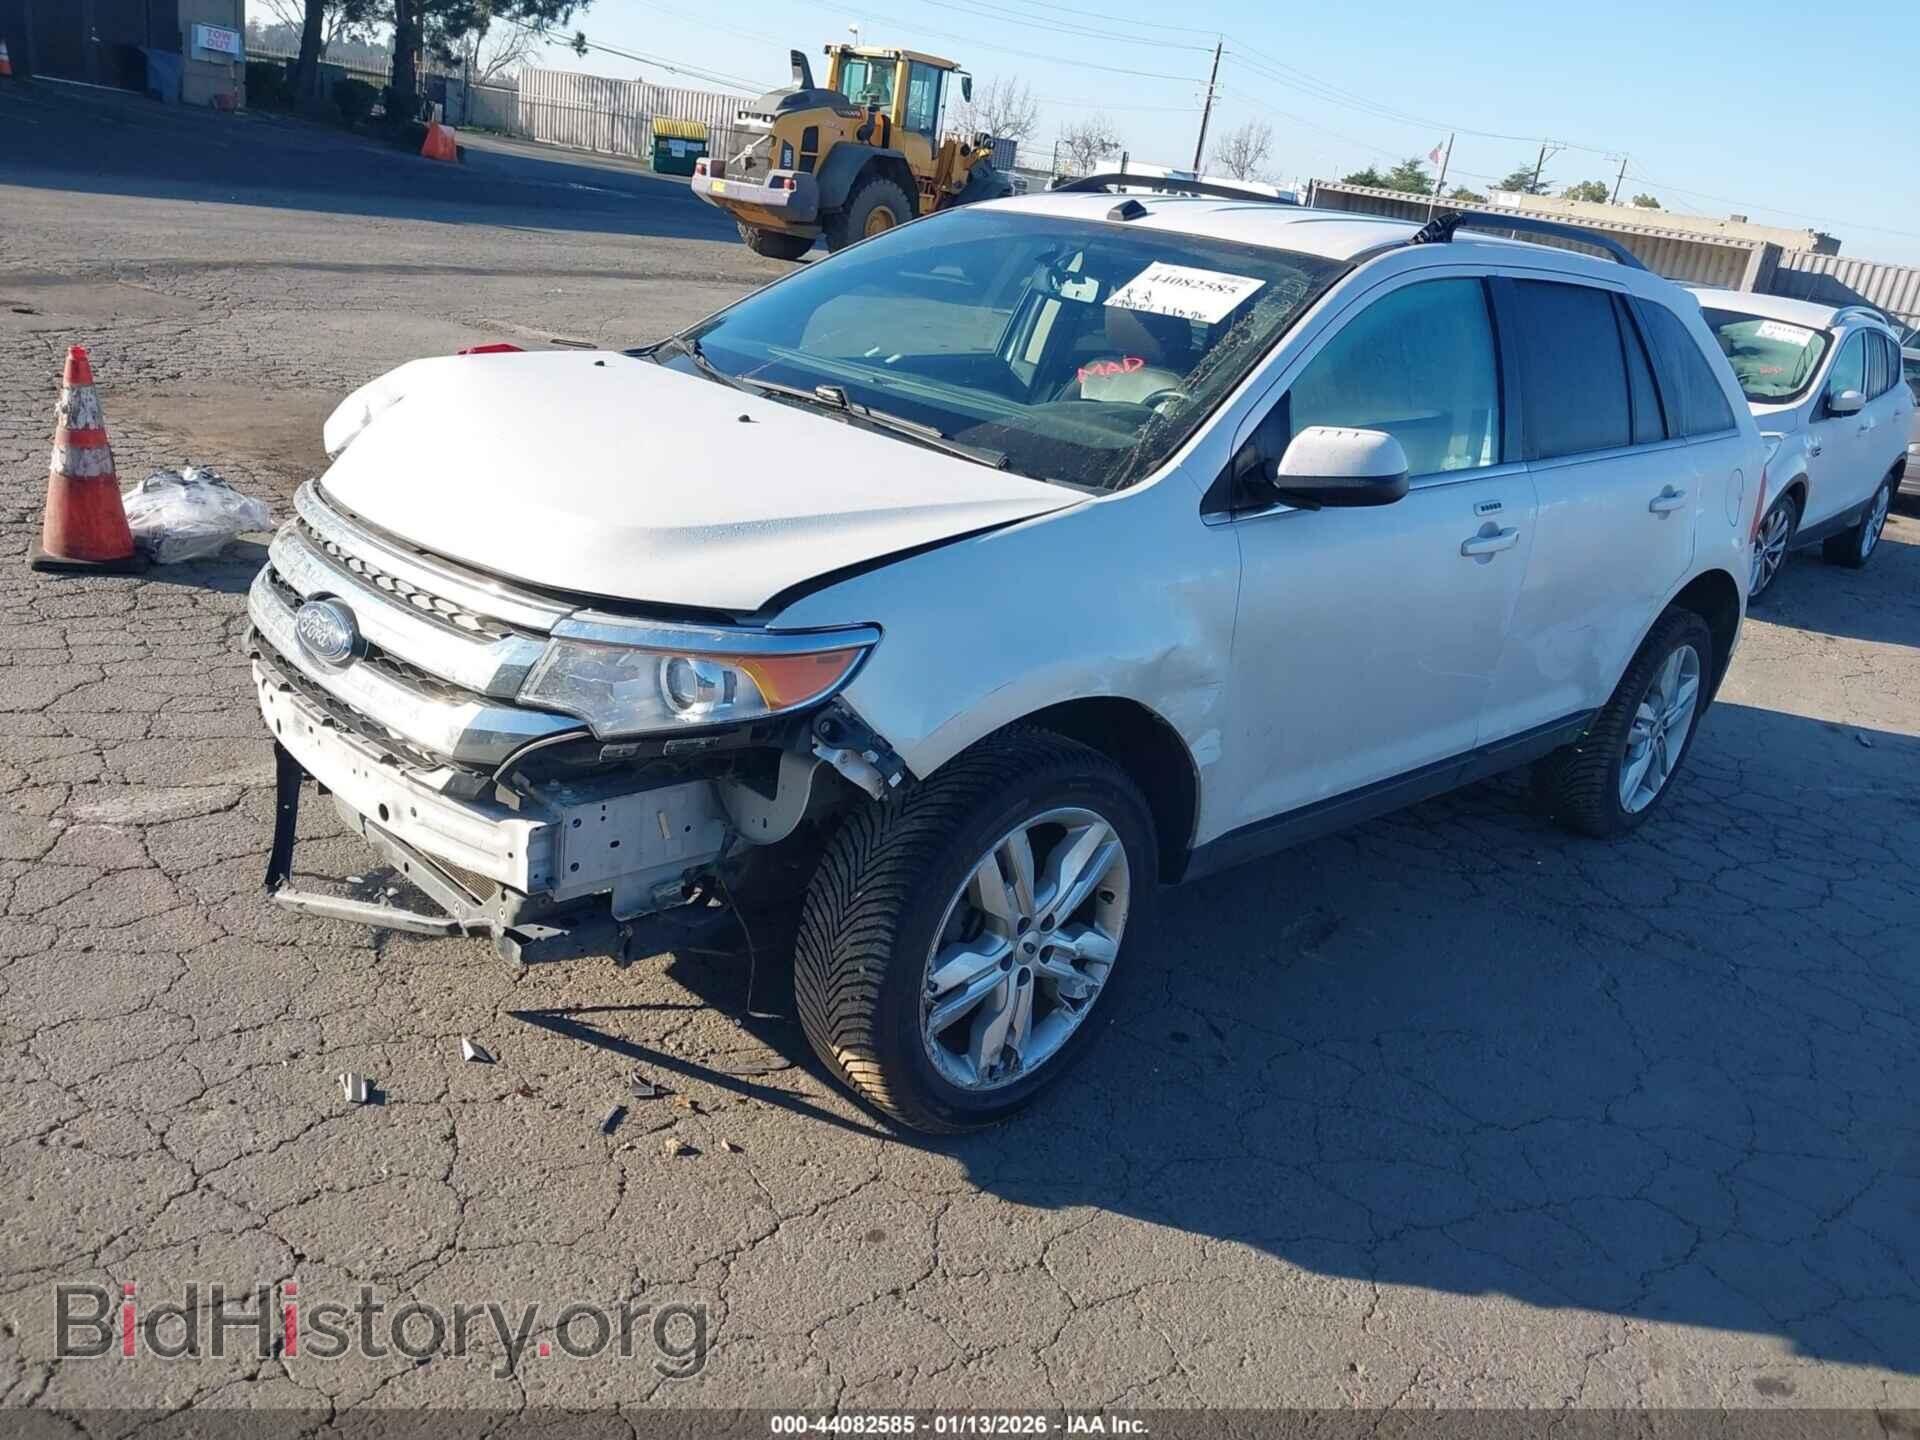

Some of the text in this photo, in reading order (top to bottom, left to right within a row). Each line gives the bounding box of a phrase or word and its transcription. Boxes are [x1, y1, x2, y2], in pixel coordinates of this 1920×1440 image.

[207, 29, 232, 41] TOW
[207, 38, 232, 49] OUT
[1149, 273, 1240, 296] 44082585
[300, 619, 335, 648] Ford
